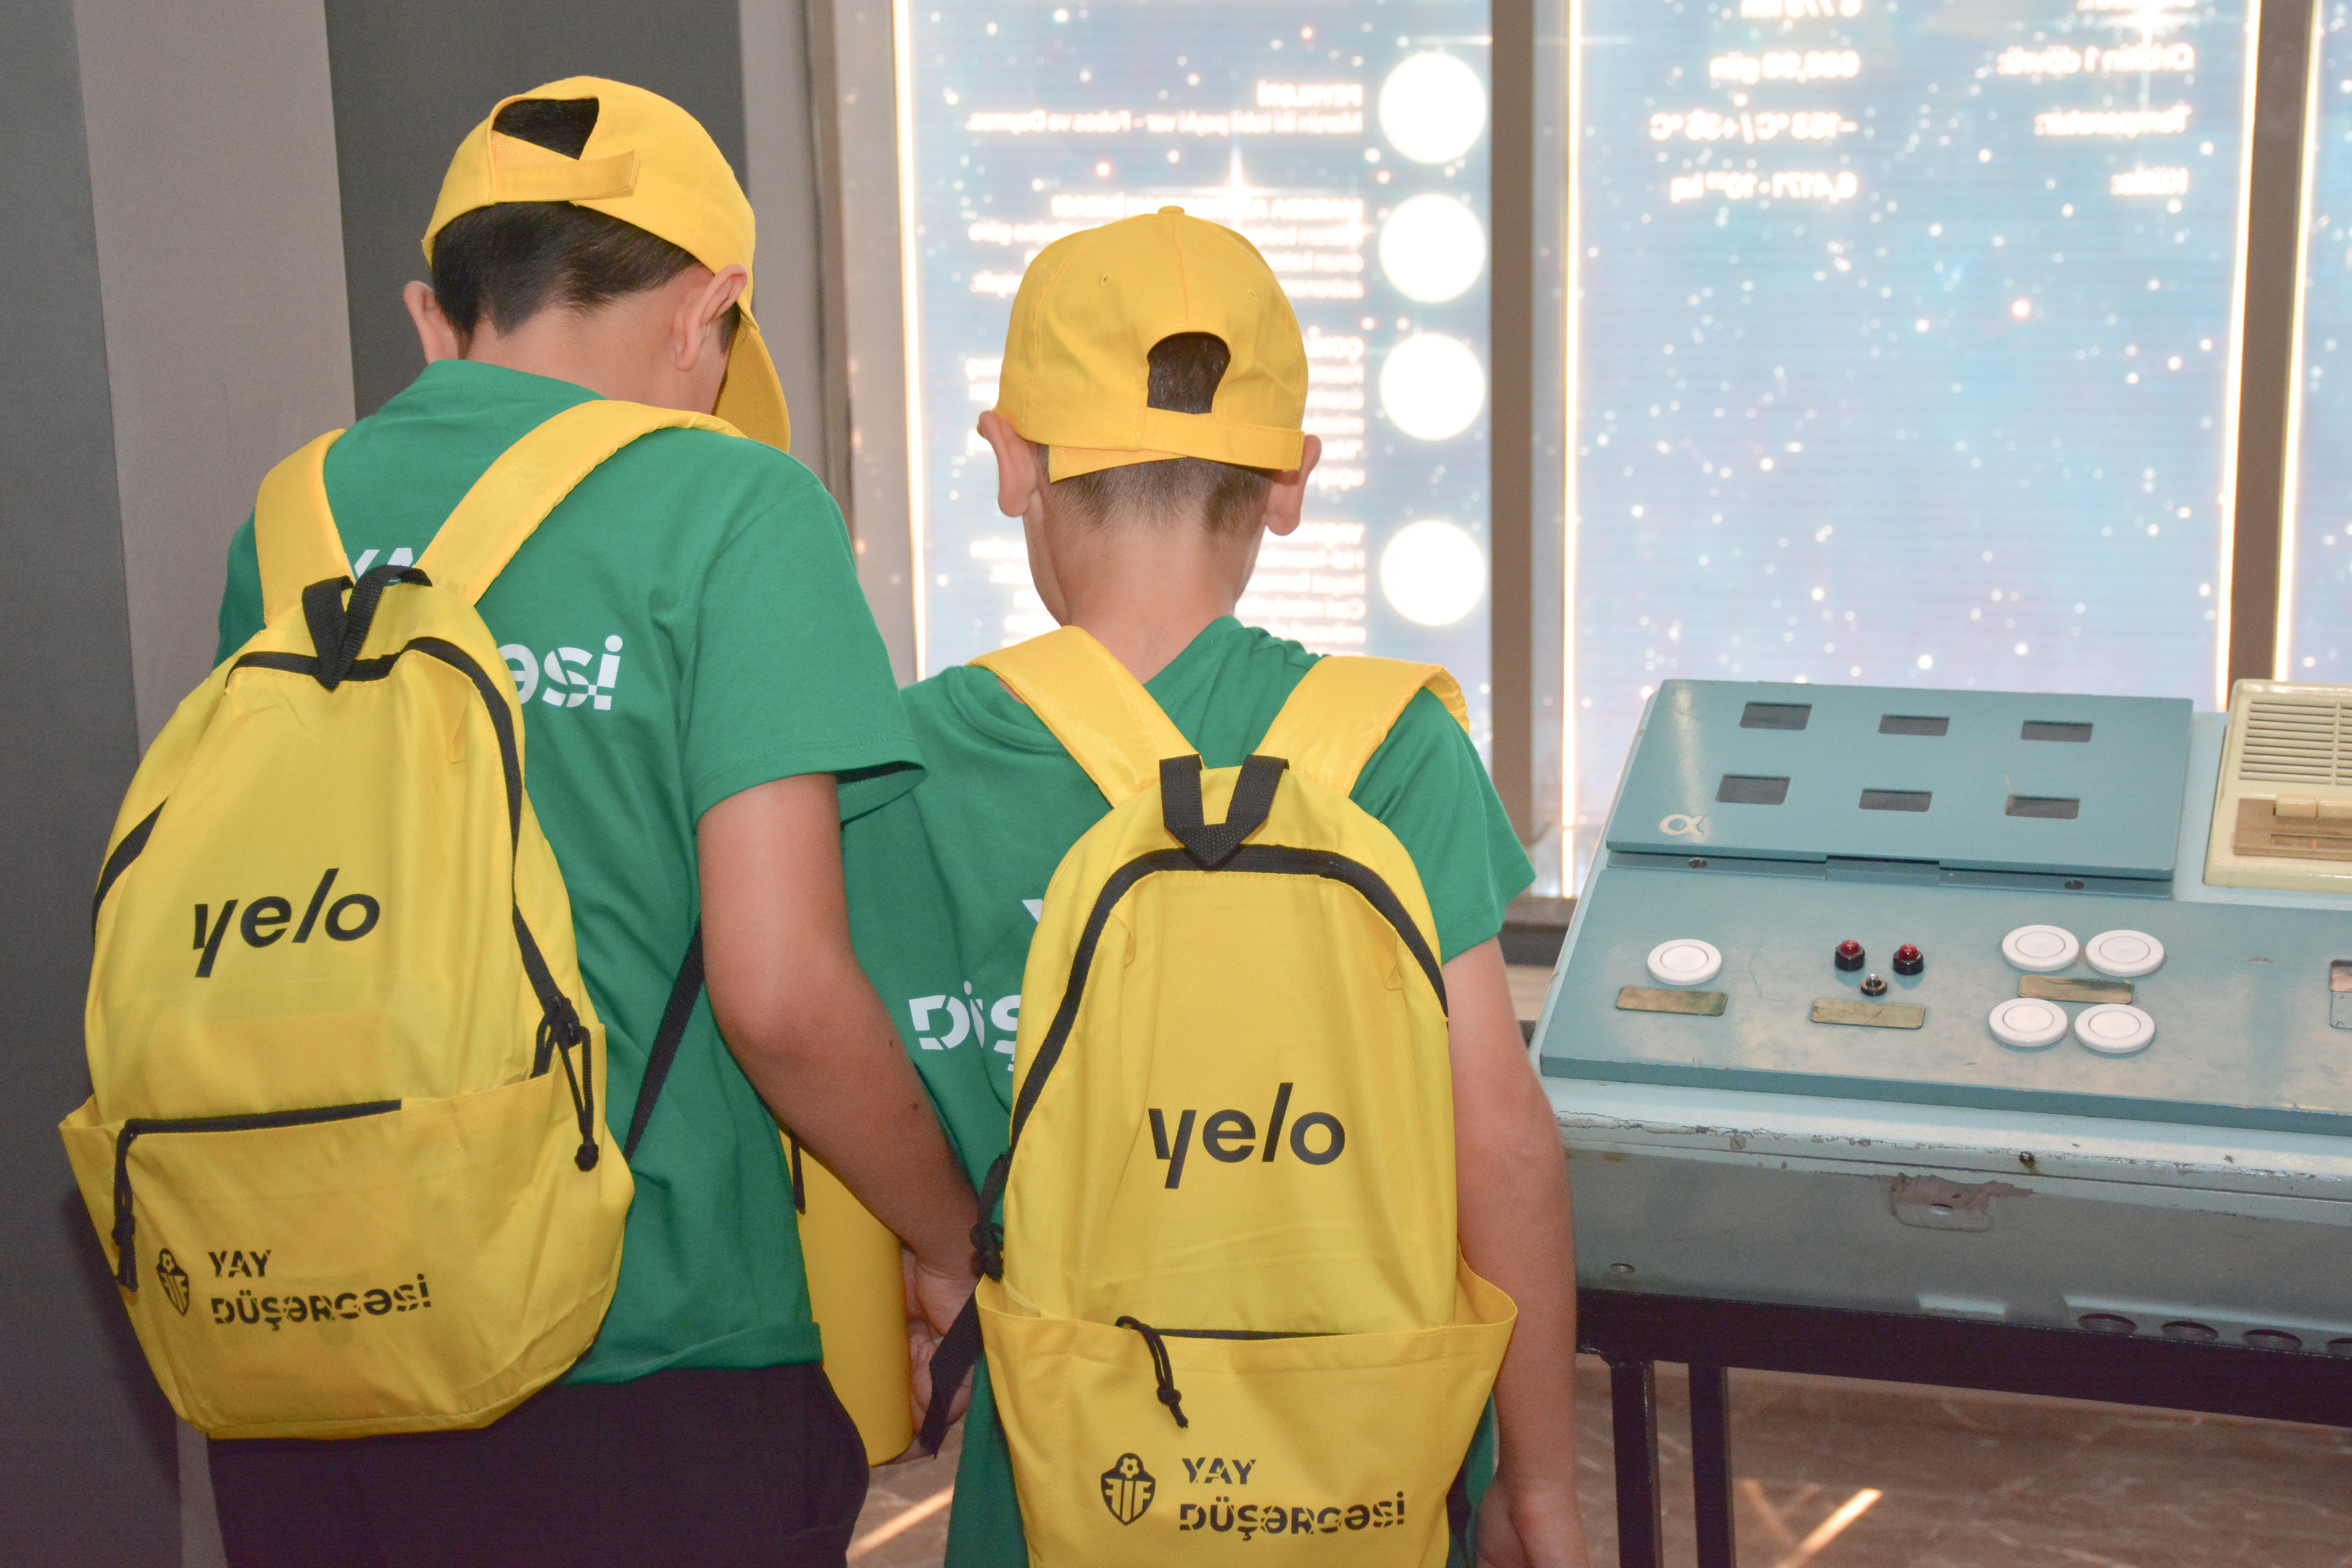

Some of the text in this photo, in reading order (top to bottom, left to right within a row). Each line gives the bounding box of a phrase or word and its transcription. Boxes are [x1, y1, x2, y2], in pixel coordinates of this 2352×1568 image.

[193, 867, 380, 977] yelo
[1148, 1082, 1345, 1189] yelo
[208, 1250, 271, 1278] YAY
[1181, 1457, 1256, 1485] YAY
